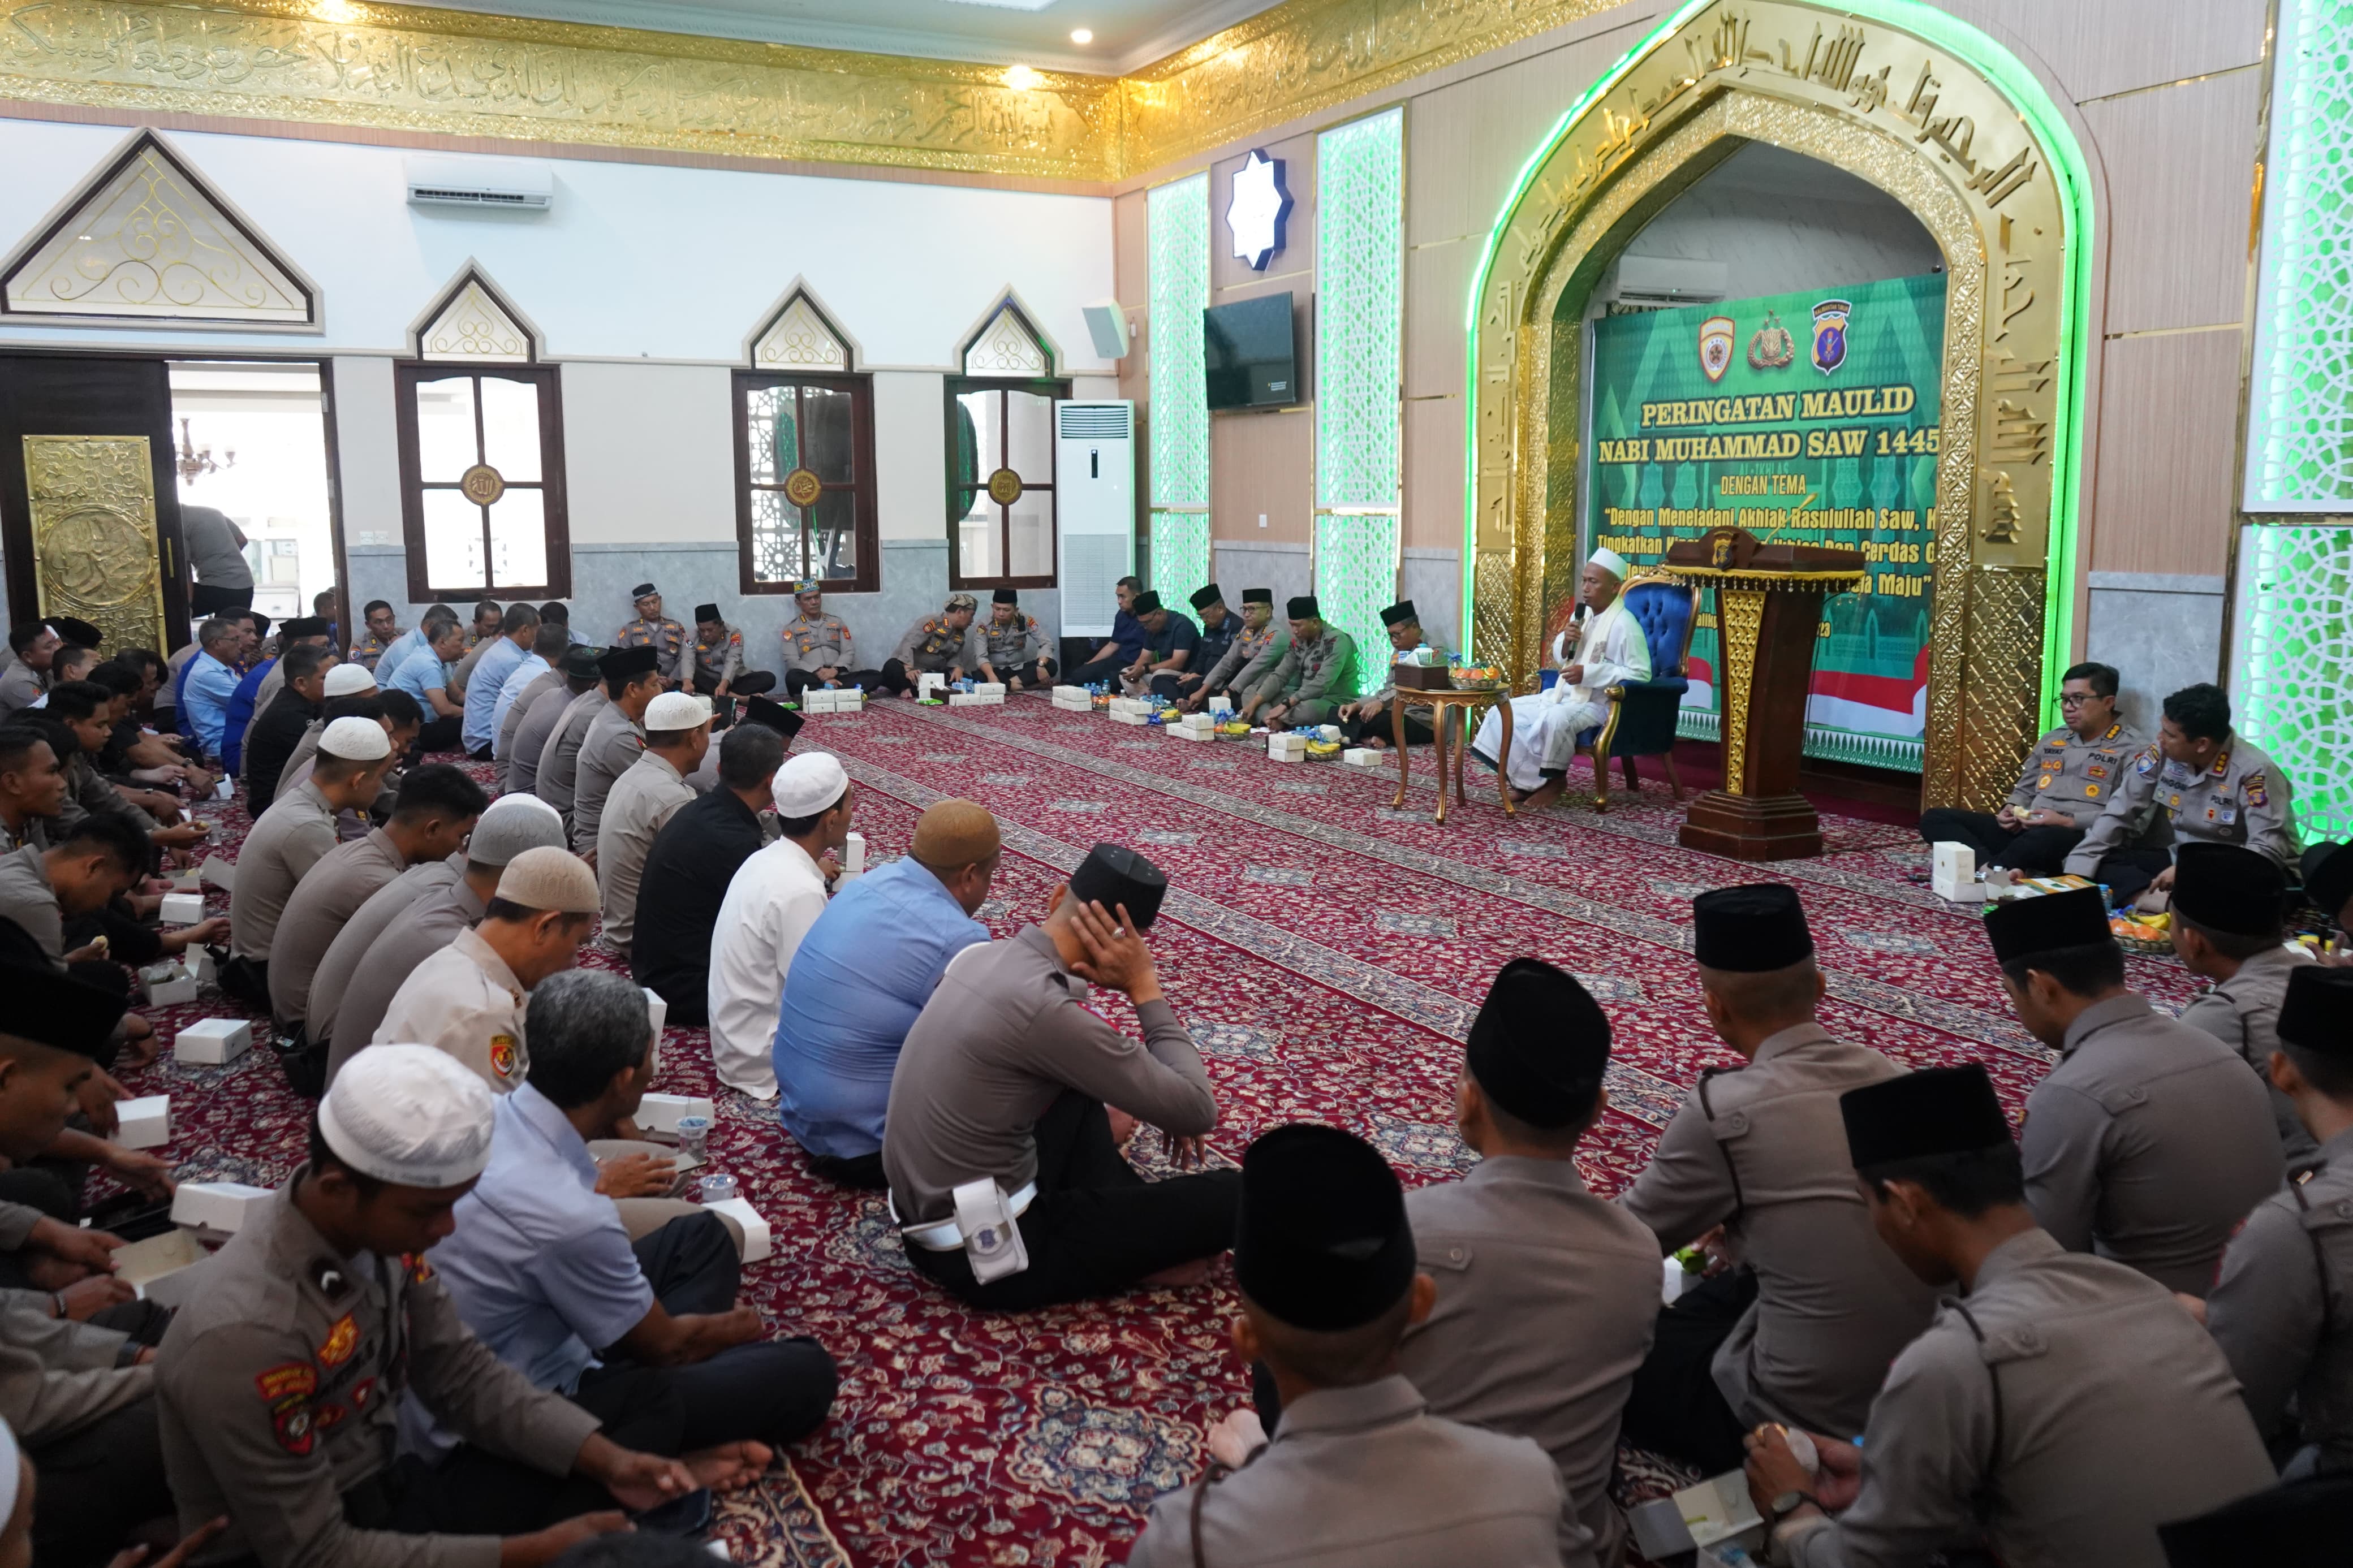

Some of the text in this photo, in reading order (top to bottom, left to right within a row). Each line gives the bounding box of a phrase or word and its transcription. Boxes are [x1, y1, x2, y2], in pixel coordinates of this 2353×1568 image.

[1641, 386, 1914, 427] PERINGATAN MAULID
[1598, 429, 1940, 463] NABI MUHAMMAD SAW 1445
[1721, 474, 1807, 495] DENGAN TEMA
[1604, 507, 1654, 527] “Dengan
[1658, 507, 1735, 527] Meneladani
[1738, 508, 1786, 528] Akhlak
[1790, 507, 1876, 529] Rasulullah
[1878, 508, 1920, 532] Saw,
[1597, 534, 1663, 554] Tingkatkan
[1860, 539, 1920, 563] Cerdas
[1878, 573, 1932, 598] Maju”
[2088, 752, 2118, 764] POLRI
[2210, 794, 2233, 805] POLRI
